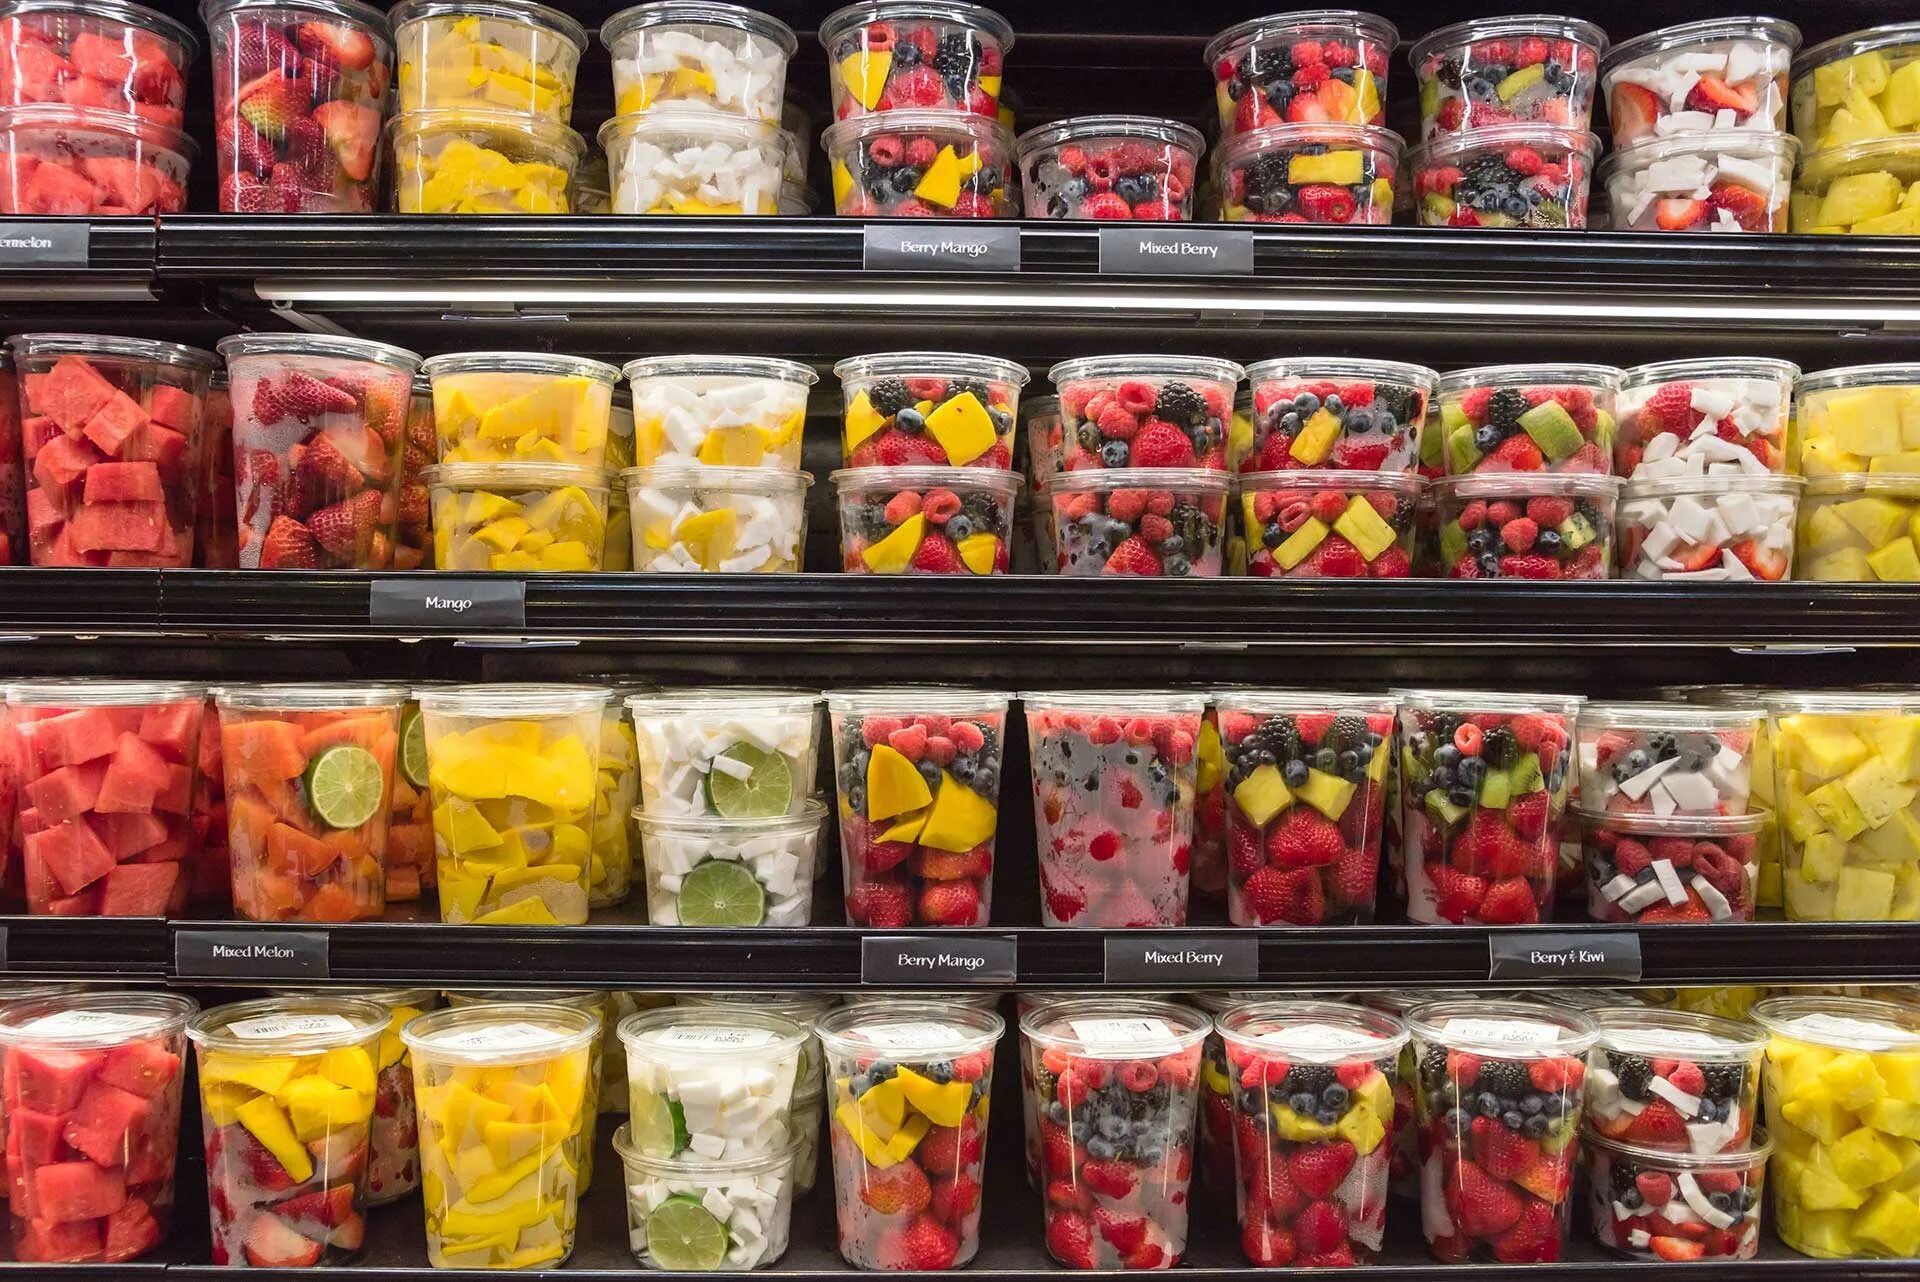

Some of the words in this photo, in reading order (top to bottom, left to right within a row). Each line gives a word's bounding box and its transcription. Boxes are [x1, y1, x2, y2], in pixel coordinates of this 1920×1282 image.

[901, 240, 938, 256] Berry
[941, 240, 988, 258] Mango
[1139, 241, 1179, 254] Mixed
[1181, 242, 1219, 258] Berry
[425, 596, 473, 612] Mango
[212, 945, 252, 958] Mixed
[254, 945, 294, 958] Melon
[1144, 951, 1184, 964] Mixed
[1186, 951, 1224, 966] Berry
[1530, 951, 1567, 966] Berry
[1579, 950, 1605, 963] Kiwi
[898, 953, 936, 969] Berry
[938, 953, 985, 971] Mango
